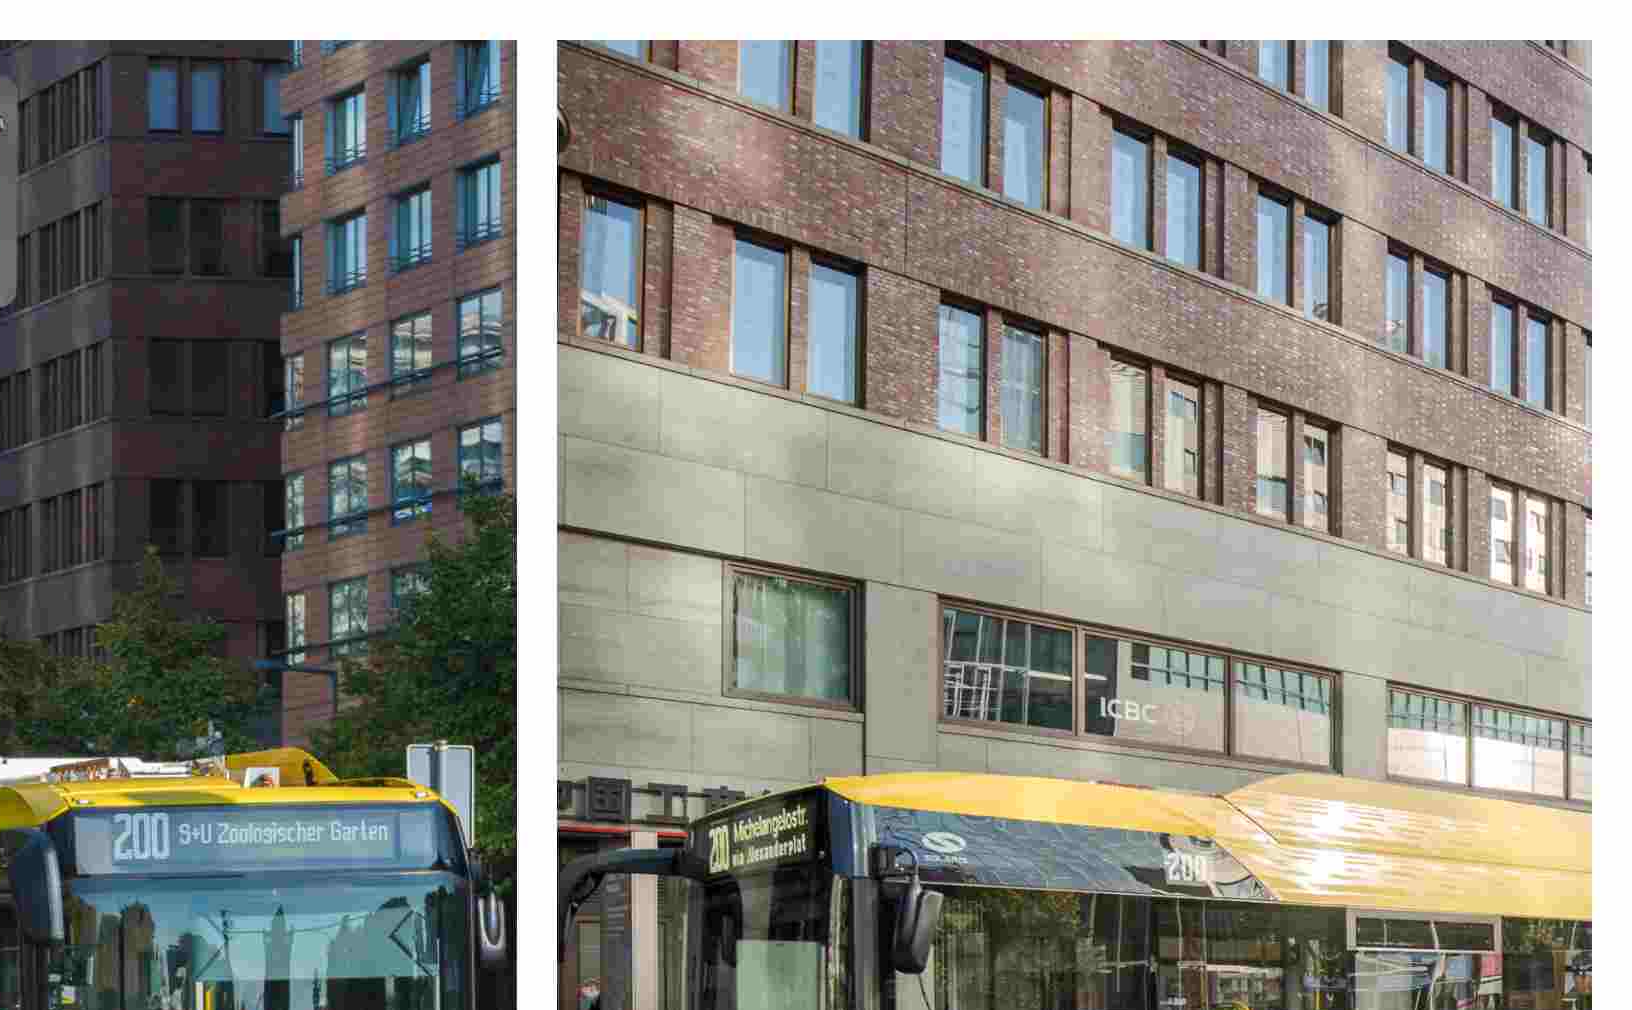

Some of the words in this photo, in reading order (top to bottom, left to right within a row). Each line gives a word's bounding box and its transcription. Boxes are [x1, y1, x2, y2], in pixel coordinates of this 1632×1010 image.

[1099, 696, 1158, 725] ICBC
[113, 812, 170, 861] 200
[178, 823, 213, 846] S+U
[218, 820, 327, 845] Zoologischer
[329, 819, 390, 842] Garten
[733, 804, 809, 843] Michelangelostr.
[708, 824, 730, 874] 200
